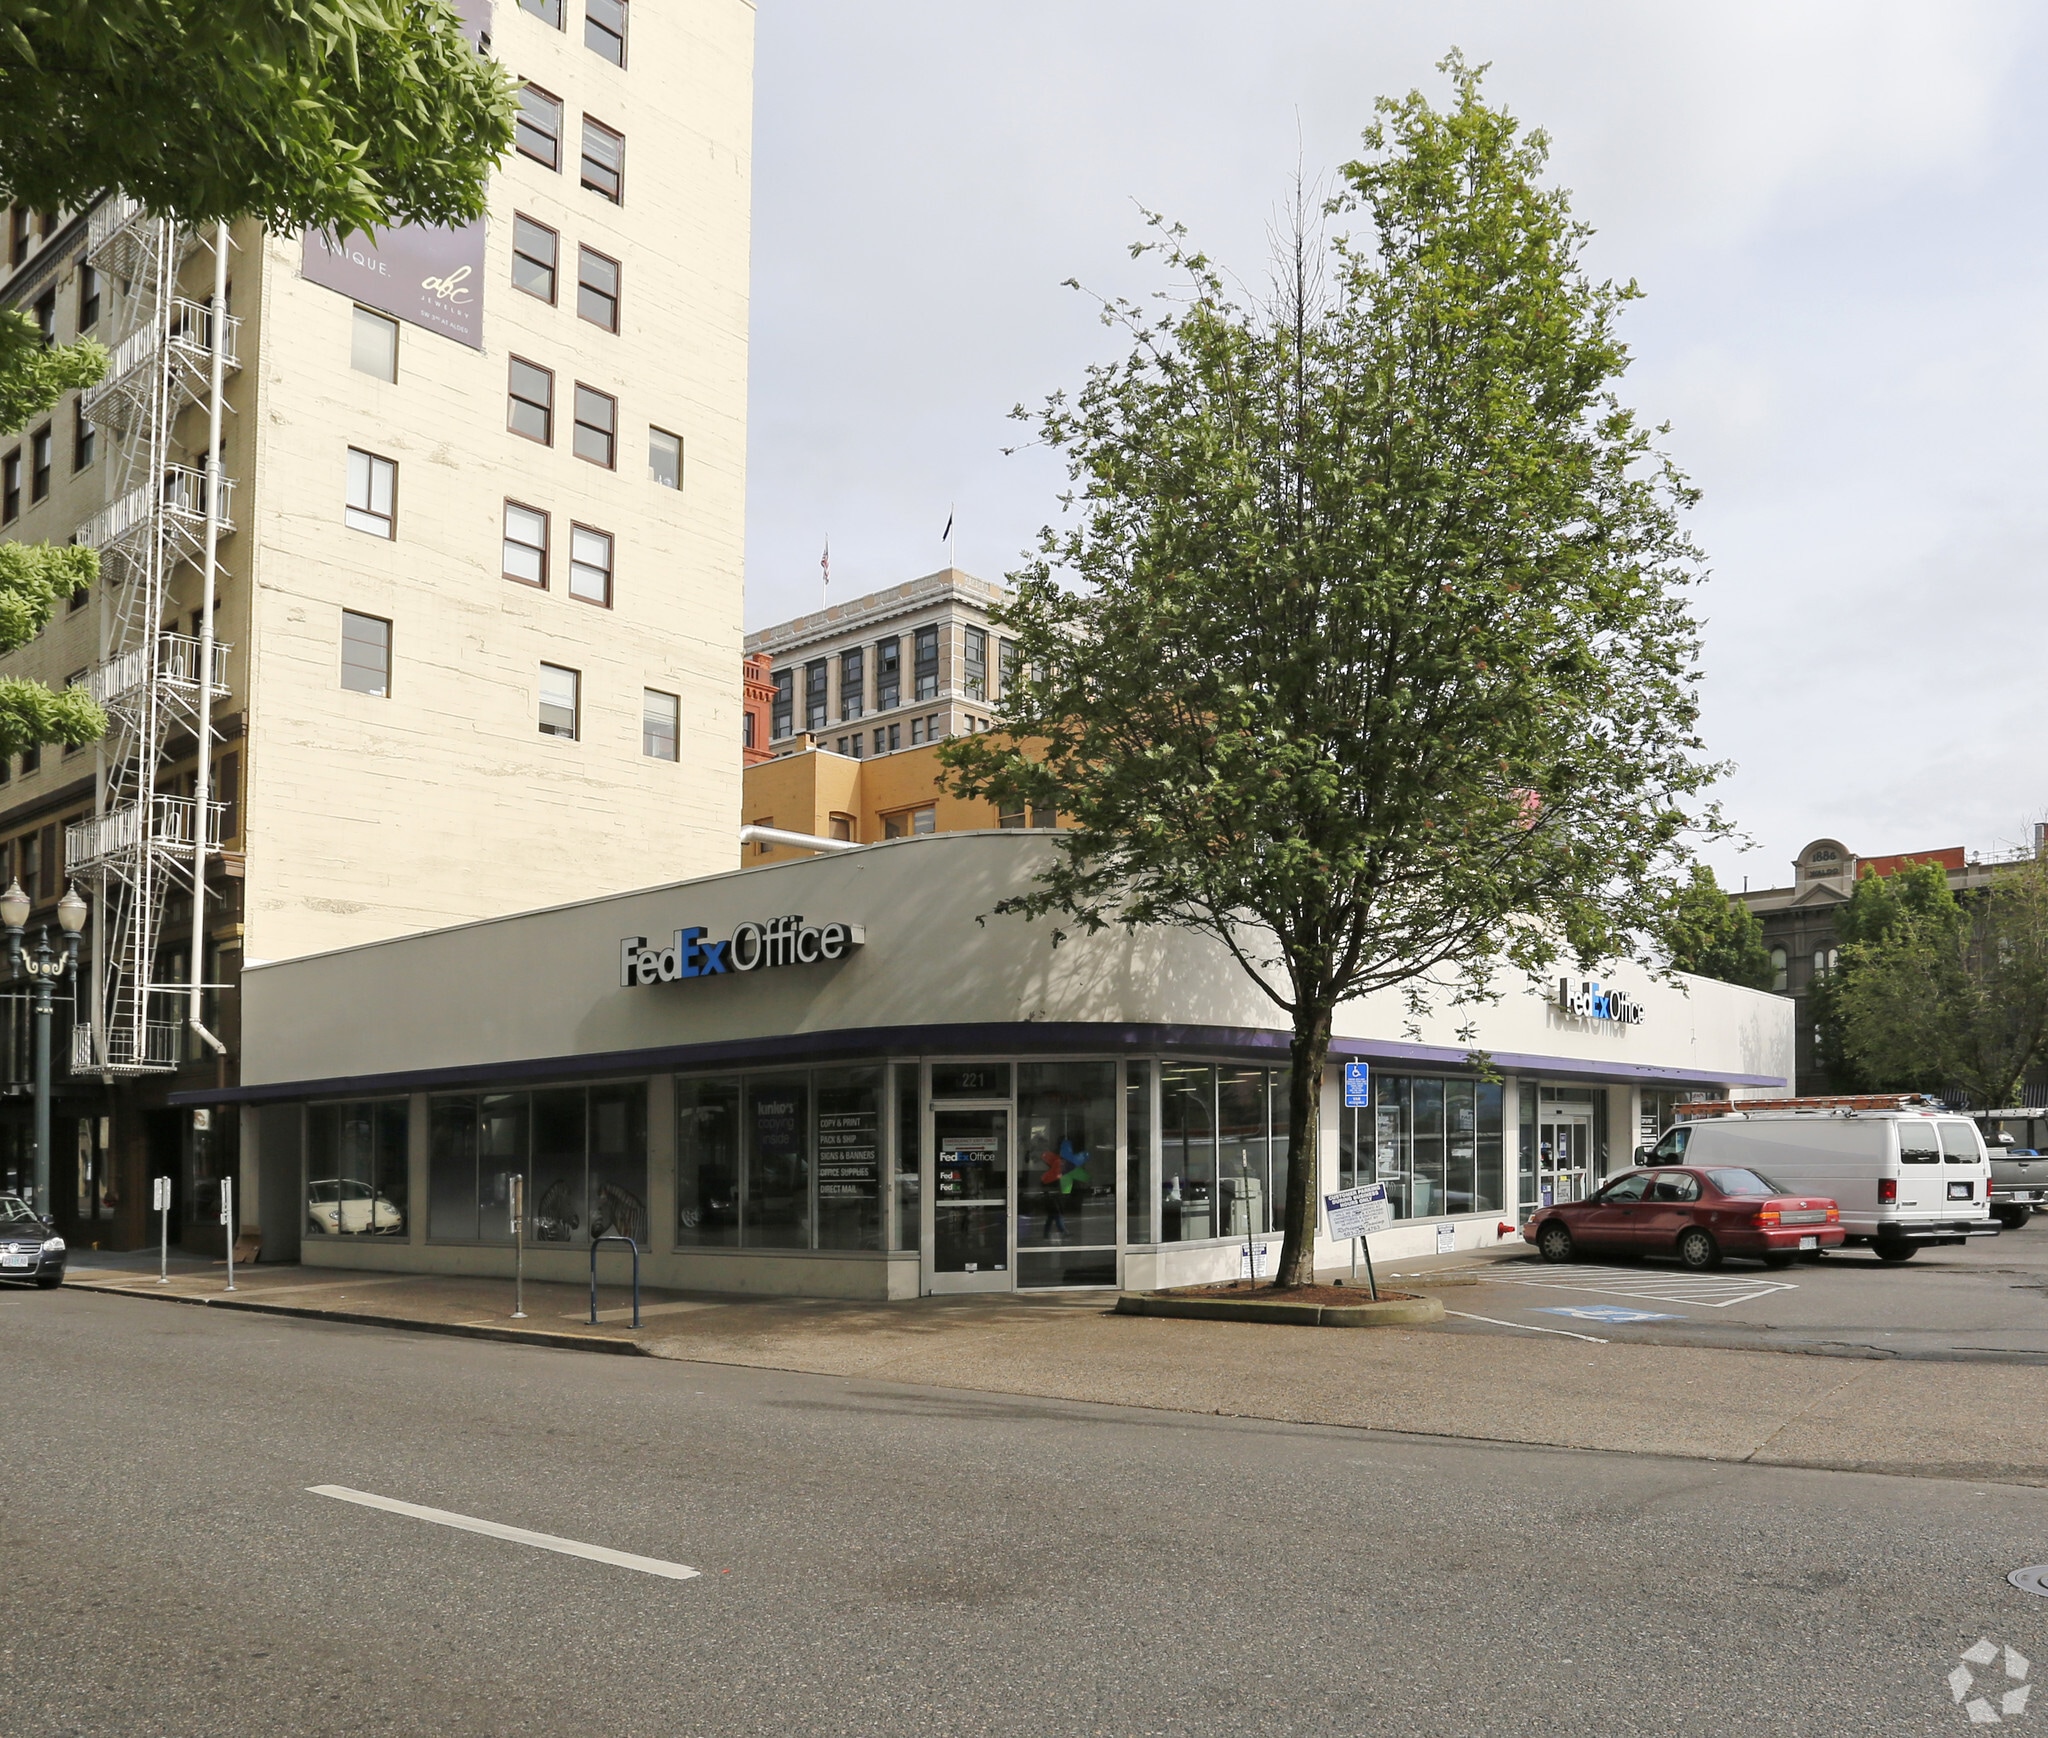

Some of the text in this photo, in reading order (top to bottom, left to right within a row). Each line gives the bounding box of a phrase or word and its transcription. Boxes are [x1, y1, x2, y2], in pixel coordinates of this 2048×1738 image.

[319, 236, 392, 278] UNIQUE.
[421, 265, 474, 304] abc
[420, 295, 470, 319] JEWELRY
[1812, 850, 1837, 862] 1886
[620, 915, 850, 987] FedEx Office
[1562, 977, 1645, 1025] FedEx Office
[962, 1072, 984, 1088] 221
[757, 1101, 794, 1115] kinko's
[758, 1117, 795, 1130] copying
[820, 1119, 836, 1128] COPY
[843, 1118, 861, 1127] PRINT
[763, 1132, 790, 1145] inside
[820, 1135, 836, 1144] PACK
[843, 1134, 857, 1143] SHIP
[820, 1152, 838, 1160] SIGNS
[846, 1150, 875, 1160] BANNERS
[939, 1151, 995, 1162] FedEx Office
[820, 1167, 869, 1177] OFFICE SUPPLIES
[820, 1185, 857, 1194] DIRECT MAIL
